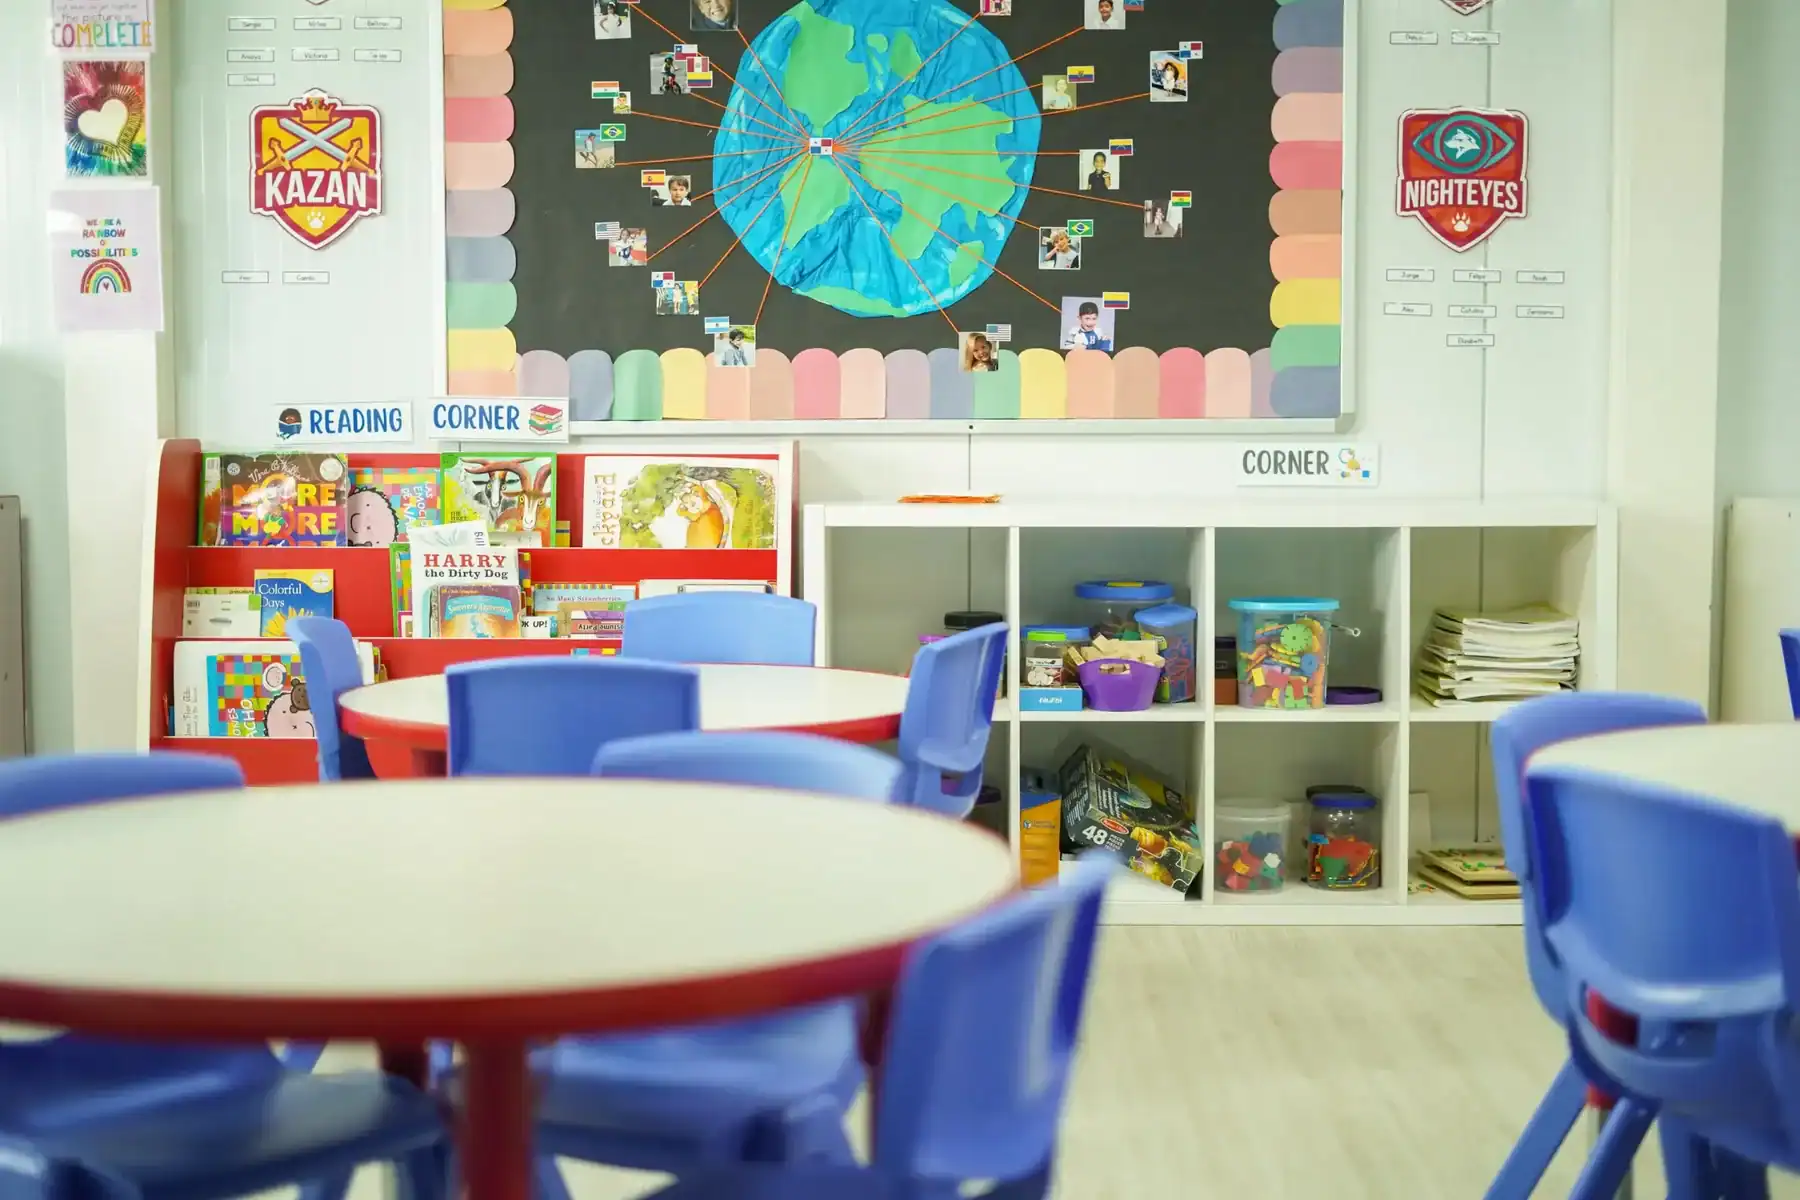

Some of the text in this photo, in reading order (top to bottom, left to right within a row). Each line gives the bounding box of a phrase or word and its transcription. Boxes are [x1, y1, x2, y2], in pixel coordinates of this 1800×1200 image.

[51, 21, 152, 48] COMPLETE
[265, 170, 367, 208] KAZAN
[1405, 179, 1518, 210] NIGHTEYES
[309, 404, 520, 434] READING CORNER
[1242, 449, 1330, 475] CORNER
[232, 511, 337, 536] MORE
[424, 554, 507, 568] HARRY
[425, 569, 509, 579] the Dirty Dog
[258, 582, 302, 595] Colorful
[261, 597, 285, 610] Days
[533, 620, 548, 628] UP!
[1082, 825, 1108, 845] 48
